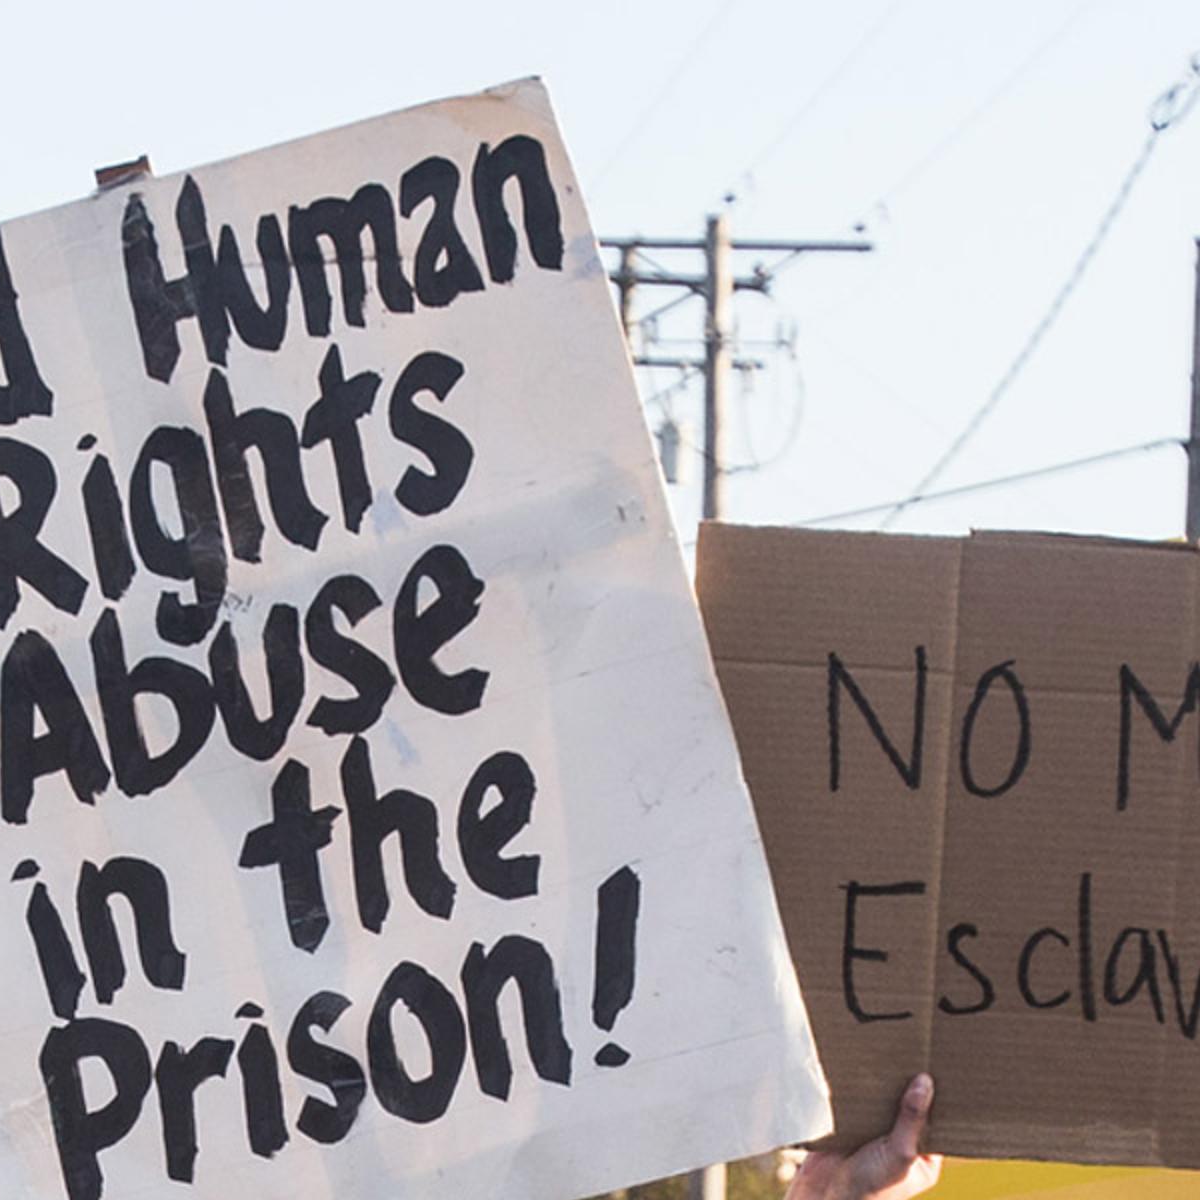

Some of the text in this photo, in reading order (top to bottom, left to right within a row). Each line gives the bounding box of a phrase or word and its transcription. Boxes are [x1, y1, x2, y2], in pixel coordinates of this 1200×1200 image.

[122, 135, 563, 384] Human
[0, 545, 489, 824] Abuse
[828, 645, 1031, 798] NO
[11, 735, 540, 1021] in the
